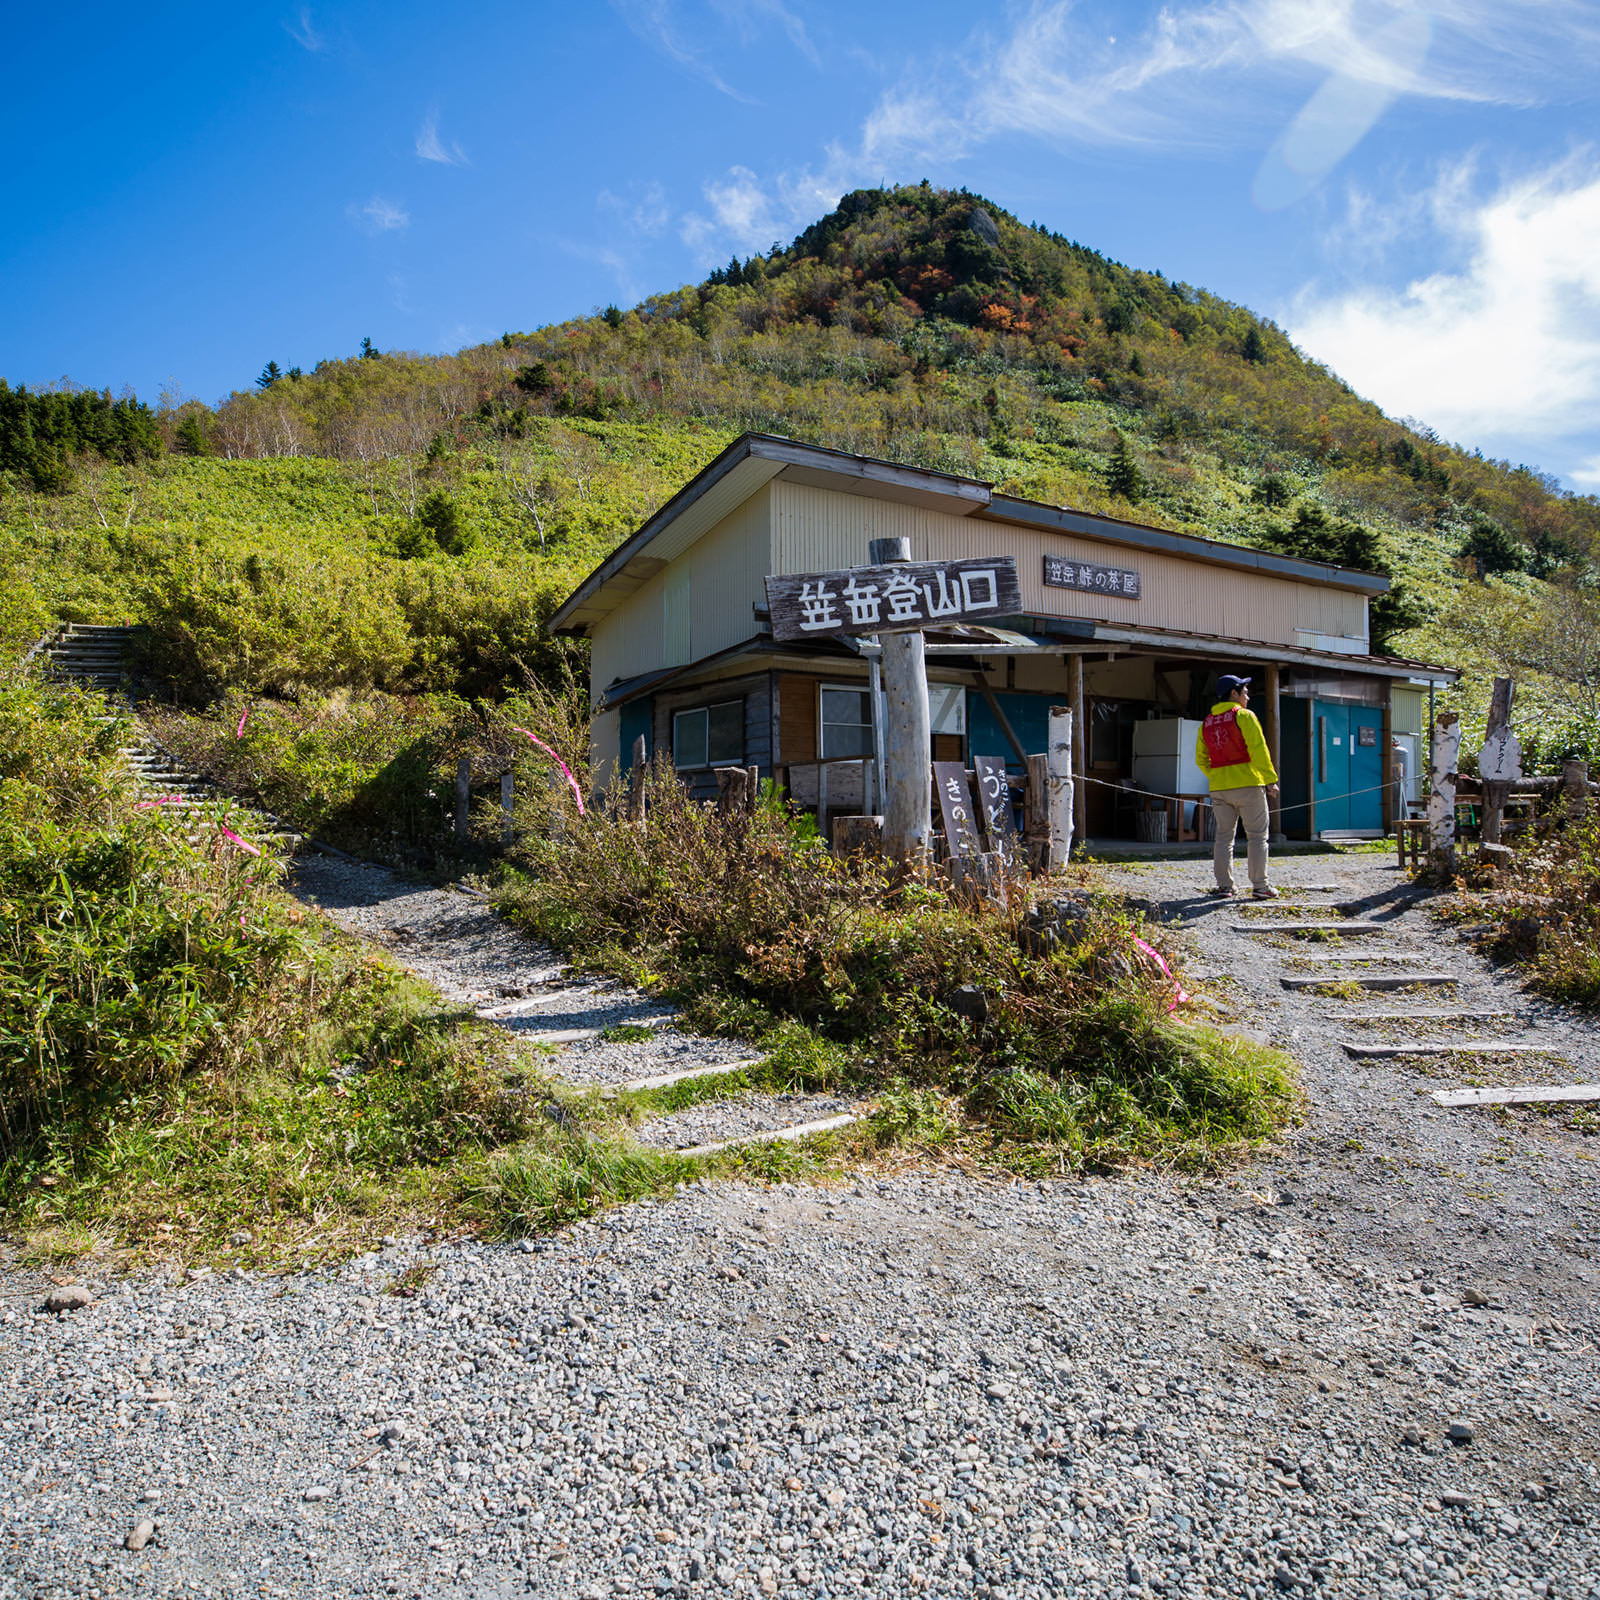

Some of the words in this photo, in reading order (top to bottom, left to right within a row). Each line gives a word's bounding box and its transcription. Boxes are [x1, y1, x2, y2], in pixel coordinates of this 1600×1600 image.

[798, 569, 998, 631] 笠岳登山口
